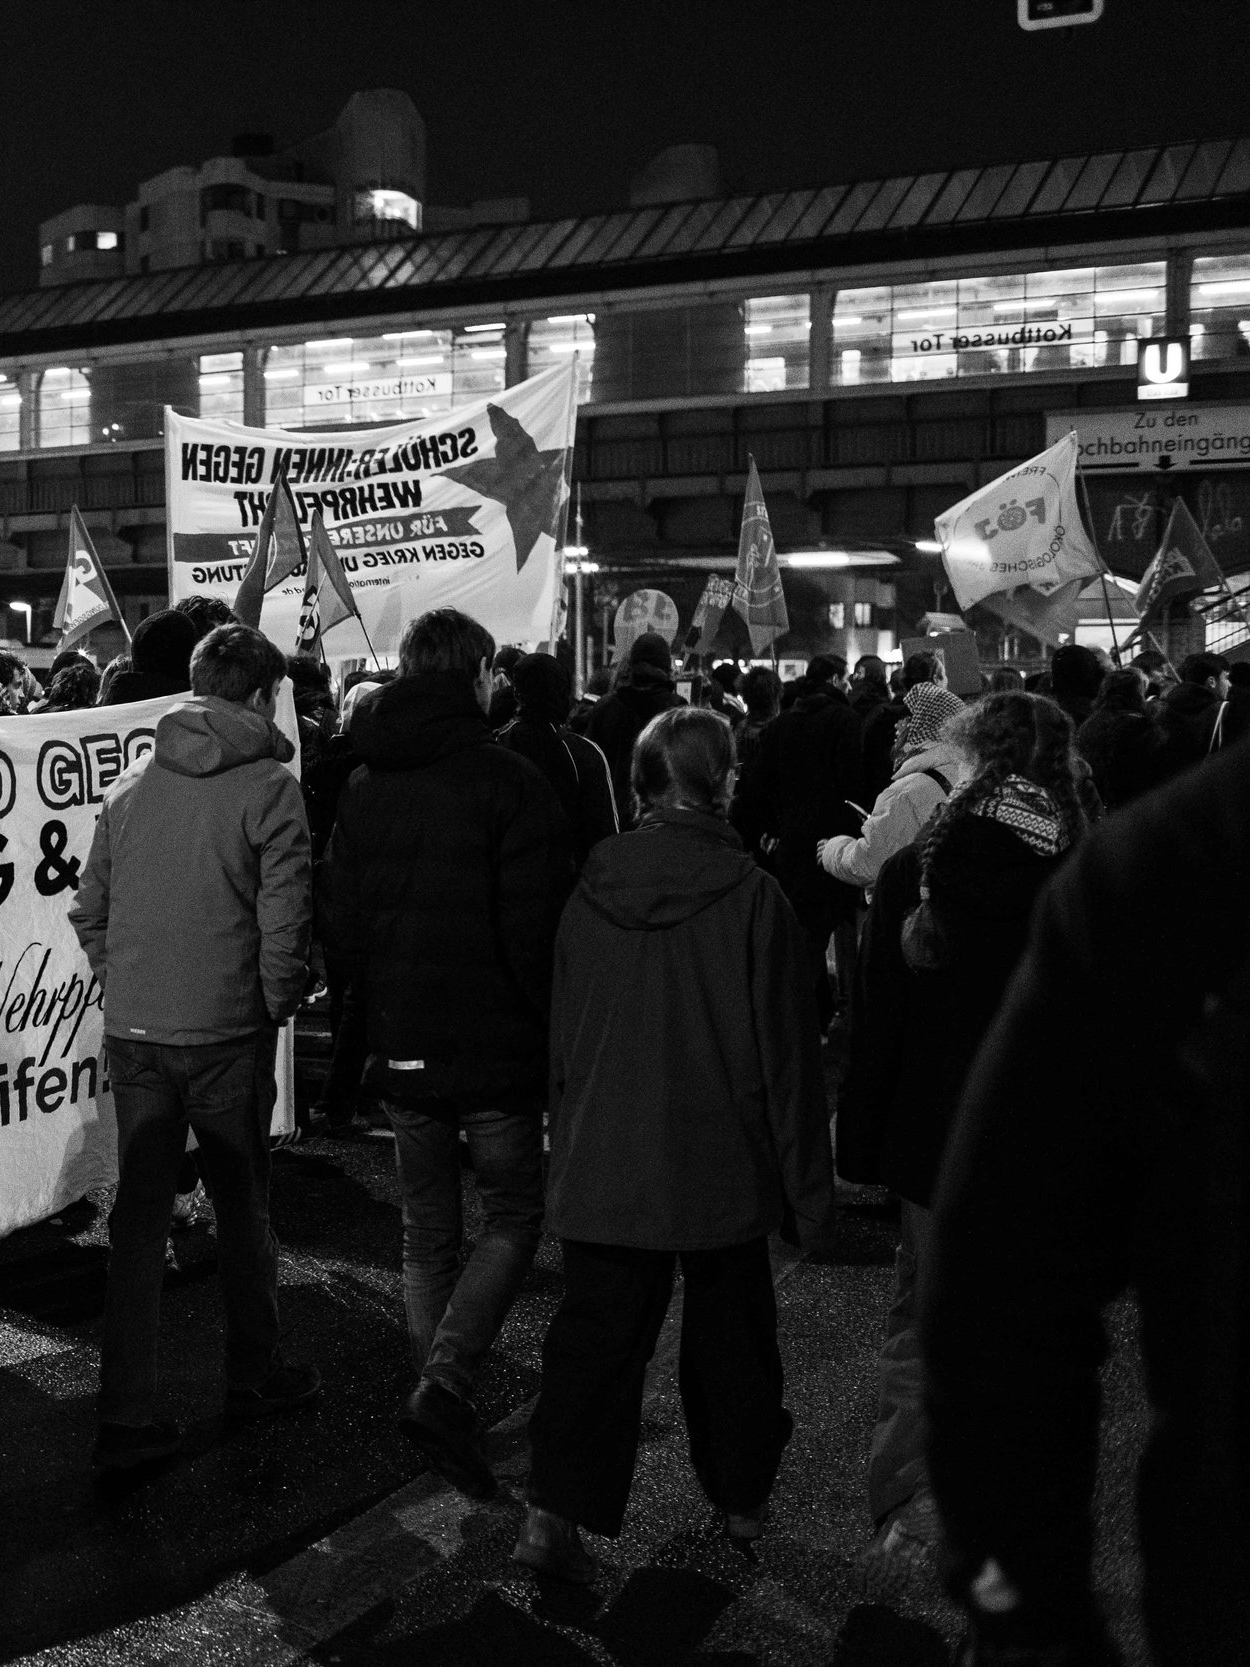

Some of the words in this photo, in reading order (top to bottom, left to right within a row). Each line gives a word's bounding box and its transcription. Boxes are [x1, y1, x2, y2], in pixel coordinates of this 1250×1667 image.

[1144, 342, 1183, 384] U
[1134, 411, 1157, 430] Zu
[1163, 411, 1199, 428] den
[1072, 430, 1250, 457] ochbahneingäng
